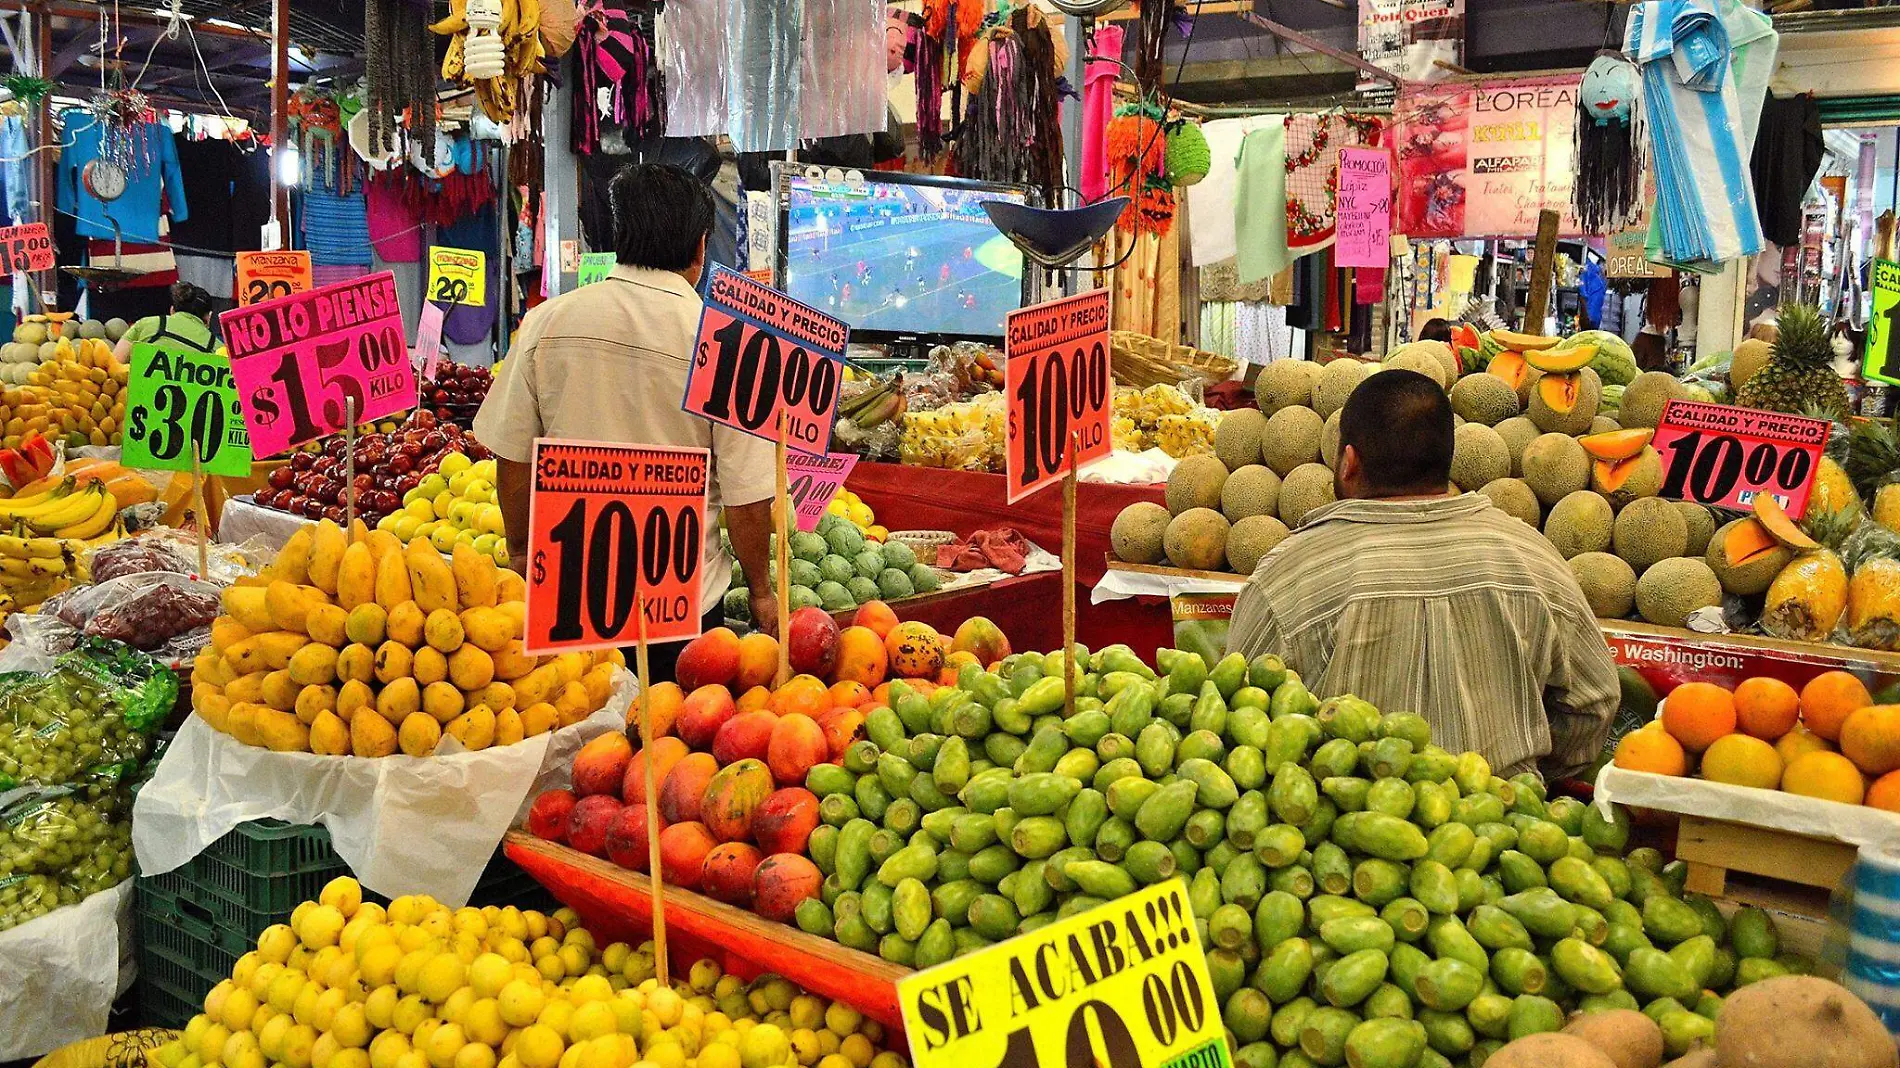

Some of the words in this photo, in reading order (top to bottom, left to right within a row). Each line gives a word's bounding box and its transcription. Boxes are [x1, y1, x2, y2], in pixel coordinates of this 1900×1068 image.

[1880, 270, 1900, 286] CA
[228, 313, 272, 355] NO
[276, 303, 310, 342] LO
[314, 281, 398, 332] PIENSE
[715, 280, 776, 317] CALIDAD
[781, 308, 791, 321] Y
[792, 313, 841, 345] PRECIO
[1012, 318, 1058, 345] CALIDAD
[1061, 314, 1069, 331] Y
[1070, 304, 1105, 328] PRECIO
[370, 372, 405, 399] KILO
[1672, 408, 1739, 426] CALIDAD
[1744, 418, 1754, 428] Y
[1757, 419, 1818, 438] PRECIO
[543, 458, 623, 480] CALIDAD
[628, 463, 639, 480] Y
[644, 463, 701, 483] PRECIO
[1173, 601, 1233, 614] Manzanas
[1609, 646, 1618, 657] e
[918, 974, 983, 1050] SE
[1009, 890, 1192, 1018] ACABA!!!
